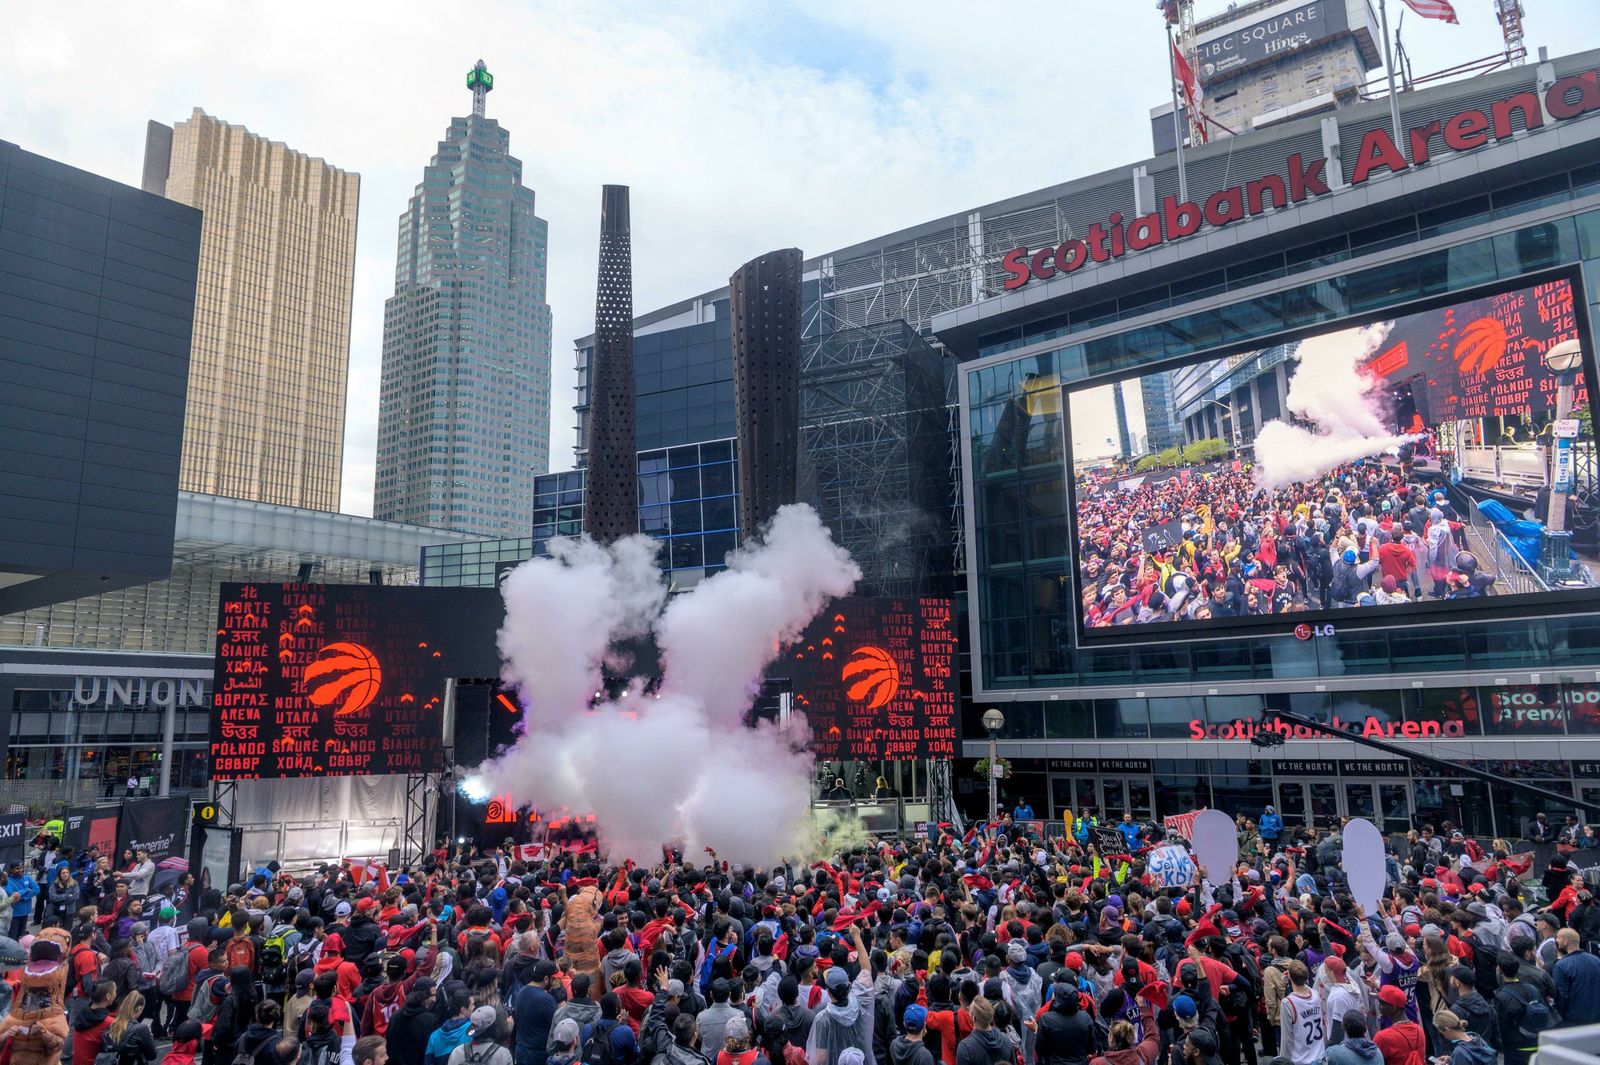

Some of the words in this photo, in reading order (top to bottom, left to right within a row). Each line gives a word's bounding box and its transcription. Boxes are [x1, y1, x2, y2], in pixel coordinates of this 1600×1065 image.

[1242, 6, 1317, 44] SQUARE
[1264, 32, 1308, 54] Hines
[1216, 58, 1247, 71] Cambridge
[1003, 152, 1331, 290] Scotiabank
[1351, 68, 1600, 184] Arena
[283, 594, 325, 606] UTARA
[224, 601, 271, 614] NORTE
[921, 607, 951, 618] UTARA
[225, 616, 268, 629] UTARA
[1315, 624, 1336, 637] LG
[921, 644, 952, 653] NORTH
[923, 656, 951, 665] KUZEY
[75, 676, 204, 705] UNION
[923, 692, 955, 703] NORTE
[221, 708, 261, 721] AREWA
[924, 704, 955, 715] UTARA
[276, 711, 318, 724] UTARA
[1362, 715, 1465, 740] Arena
[1306, 763, 1333, 771] NORTH
[1375, 763, 1404, 771] NORTH
[1579, 764, 1592, 772] WE
[1164, 871, 1193, 886] KD!
[1404, 986, 1415, 1002] 15
[1303, 1018, 1323, 1045] 23
